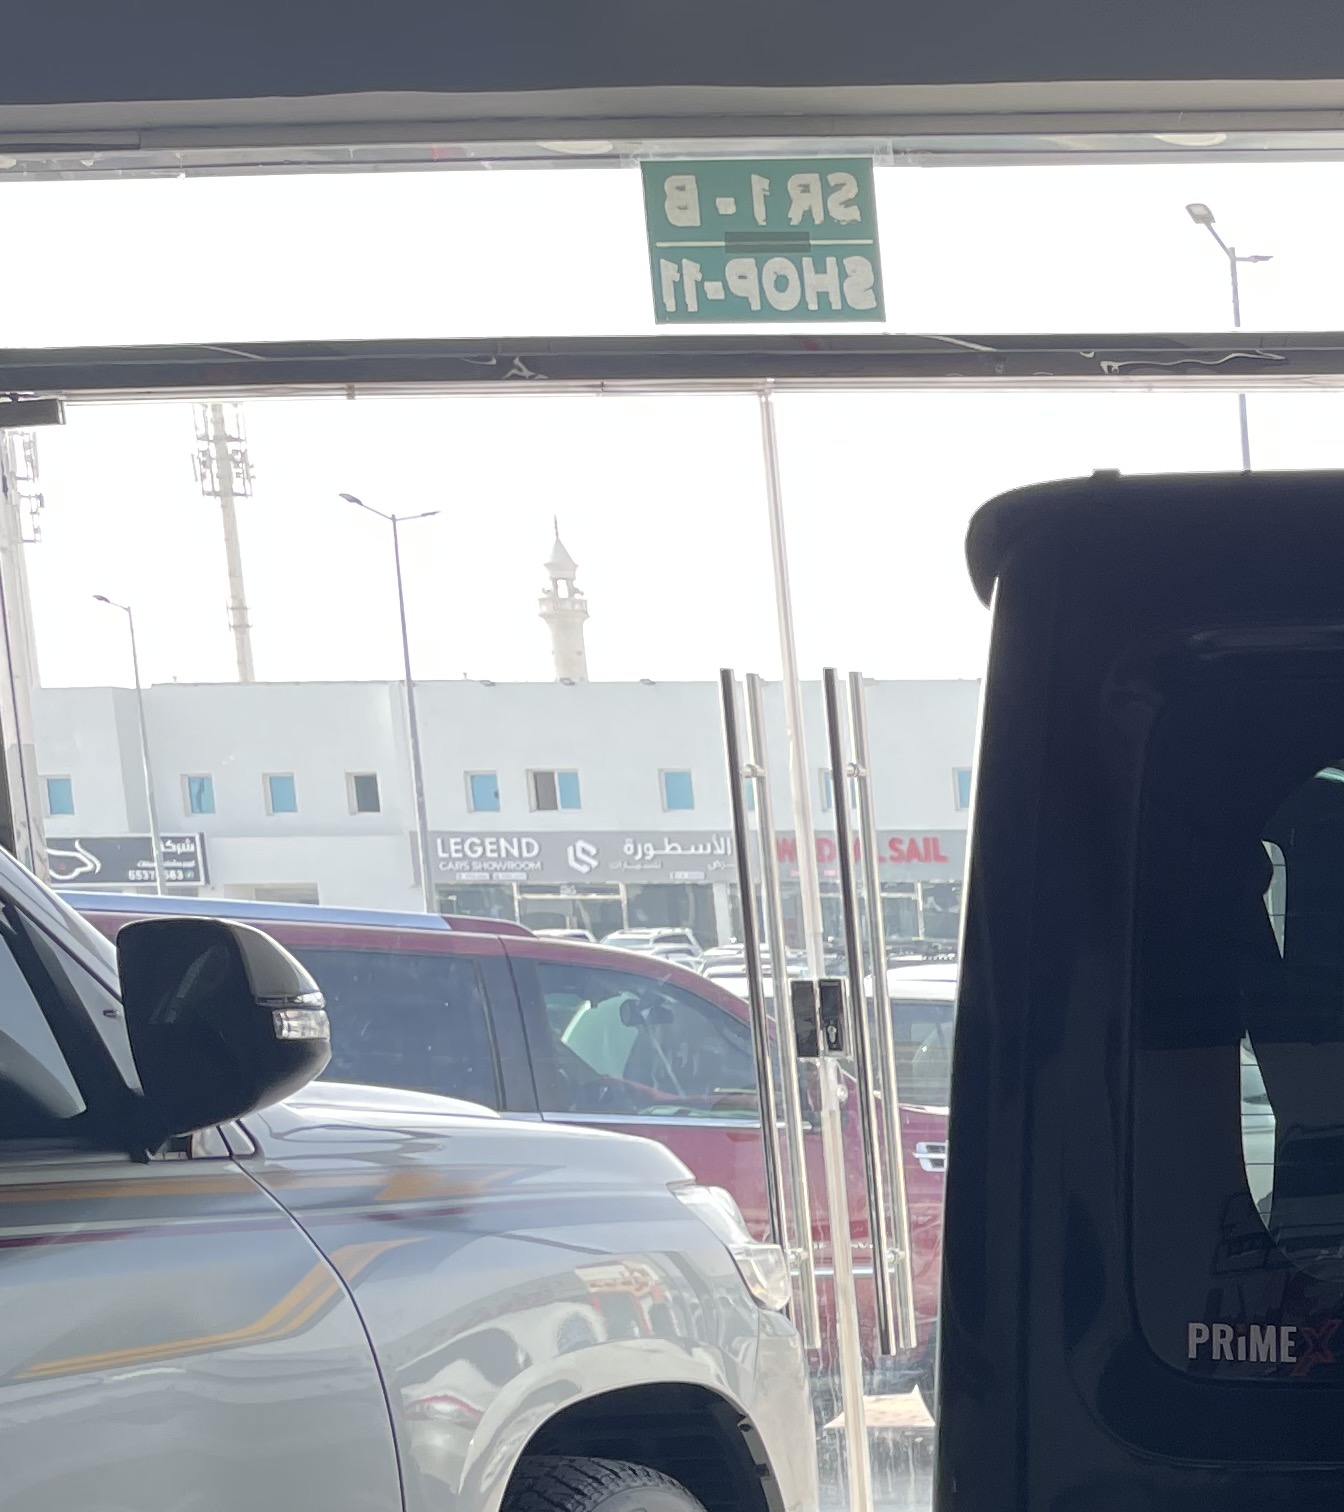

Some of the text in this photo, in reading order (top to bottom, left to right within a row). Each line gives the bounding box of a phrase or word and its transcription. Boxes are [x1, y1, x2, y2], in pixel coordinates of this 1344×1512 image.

[160, 838, 195, 855] شرك
[436, 837, 540, 858] LEGEND
[888, 837, 949, 864] SAIL
[438, 861, 542, 872] CARS SHOWROOM
